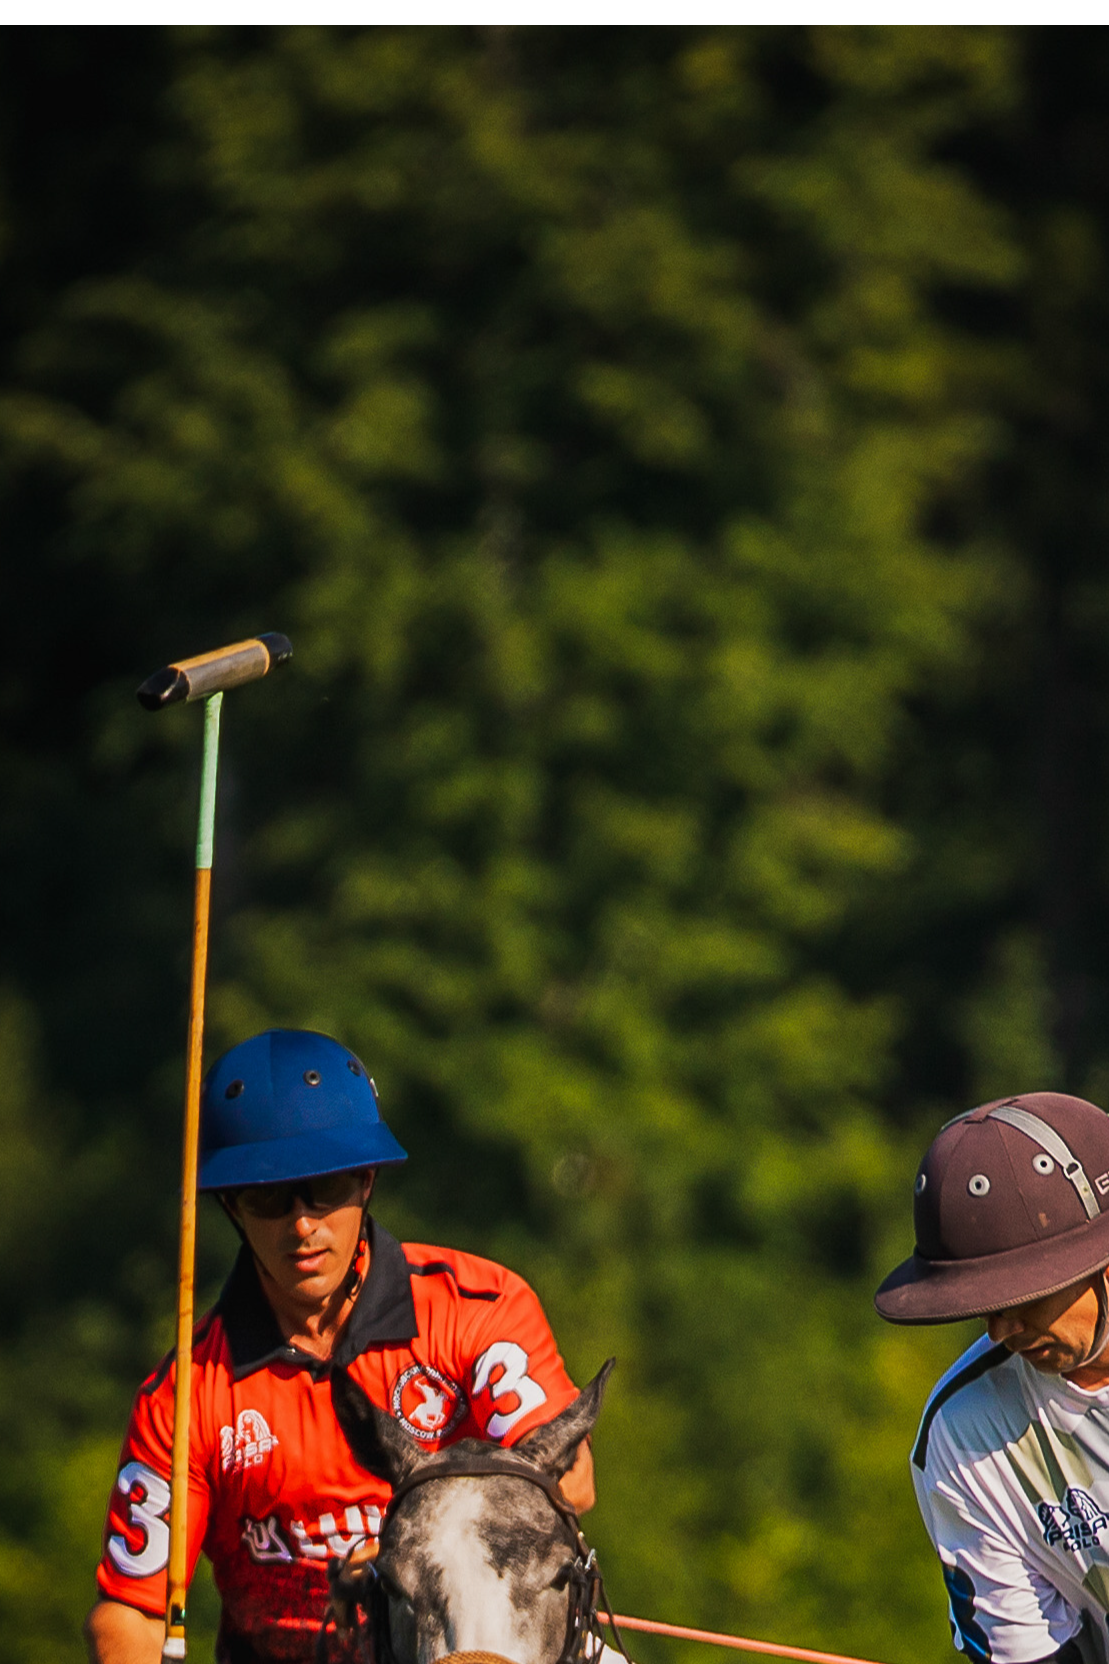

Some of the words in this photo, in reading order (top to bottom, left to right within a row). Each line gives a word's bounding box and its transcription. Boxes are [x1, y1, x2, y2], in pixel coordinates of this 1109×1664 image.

[399, 1417, 435, 1439] MOSCOW
[472, 1341, 547, 1439] 3
[108, 1461, 171, 1578] 3
